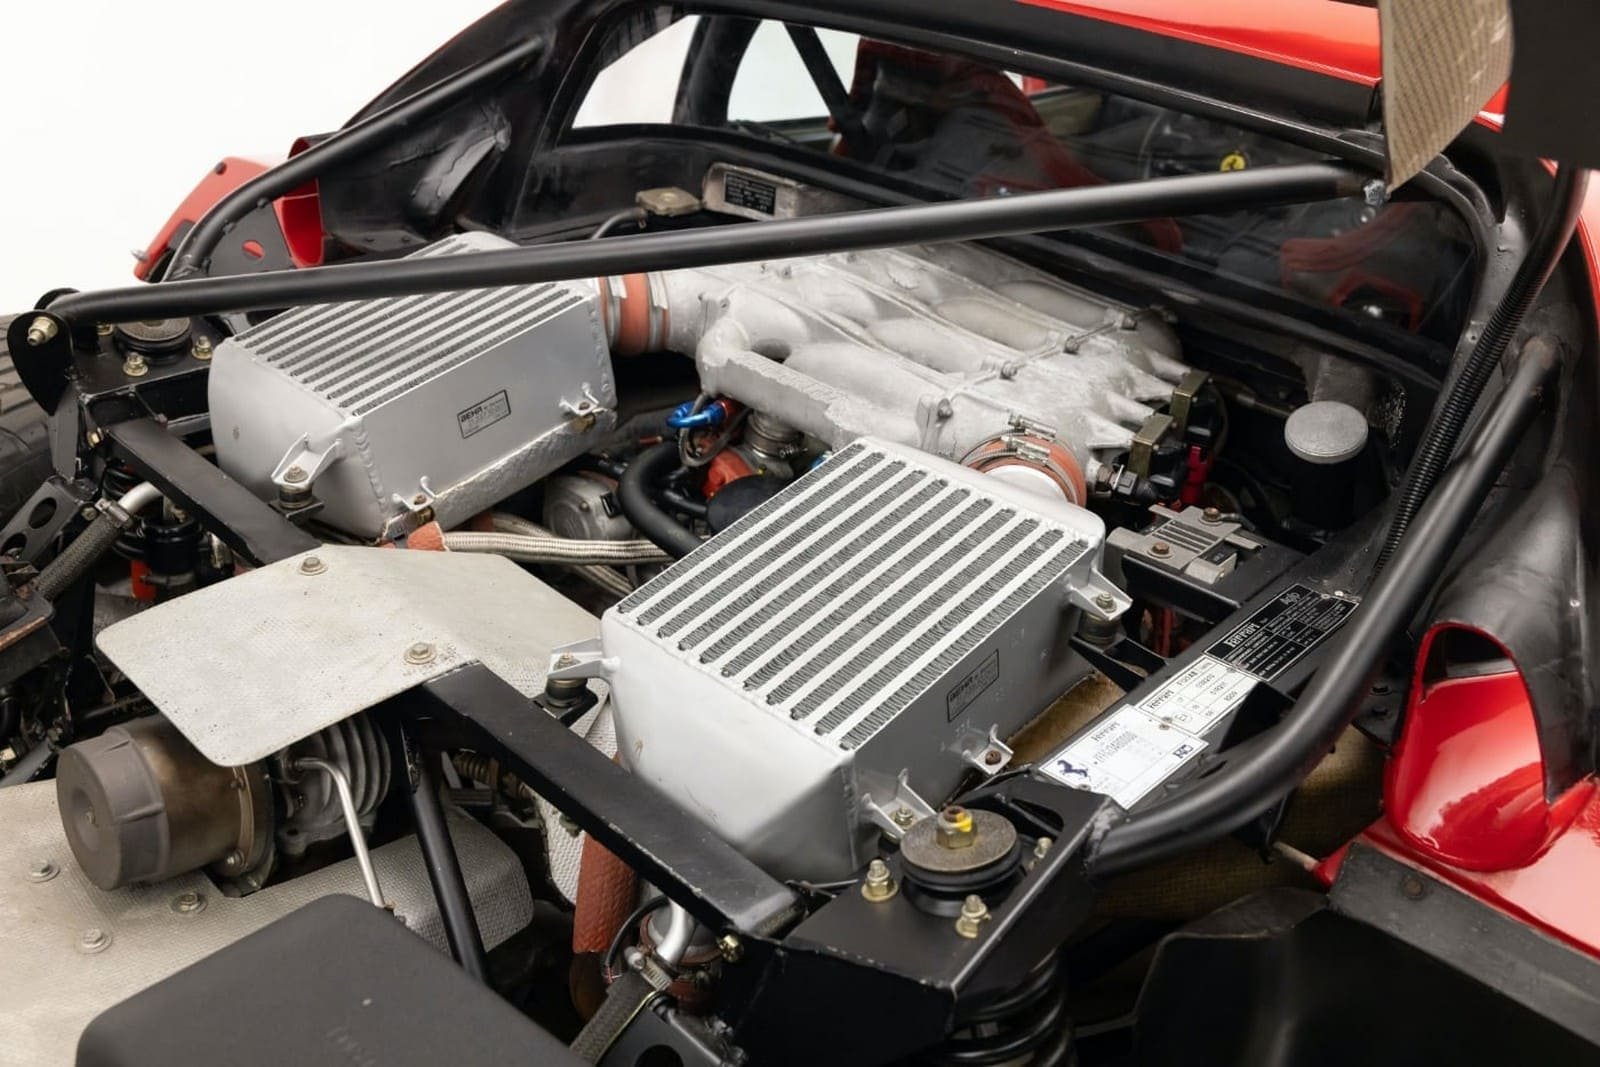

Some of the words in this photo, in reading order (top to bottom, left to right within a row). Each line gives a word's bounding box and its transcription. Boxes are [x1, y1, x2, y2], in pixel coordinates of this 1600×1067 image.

[1223, 621, 1261, 648] Ferrari
[1146, 688, 1175, 709] Ferrari
[1090, 721, 1120, 742] Ferrari
